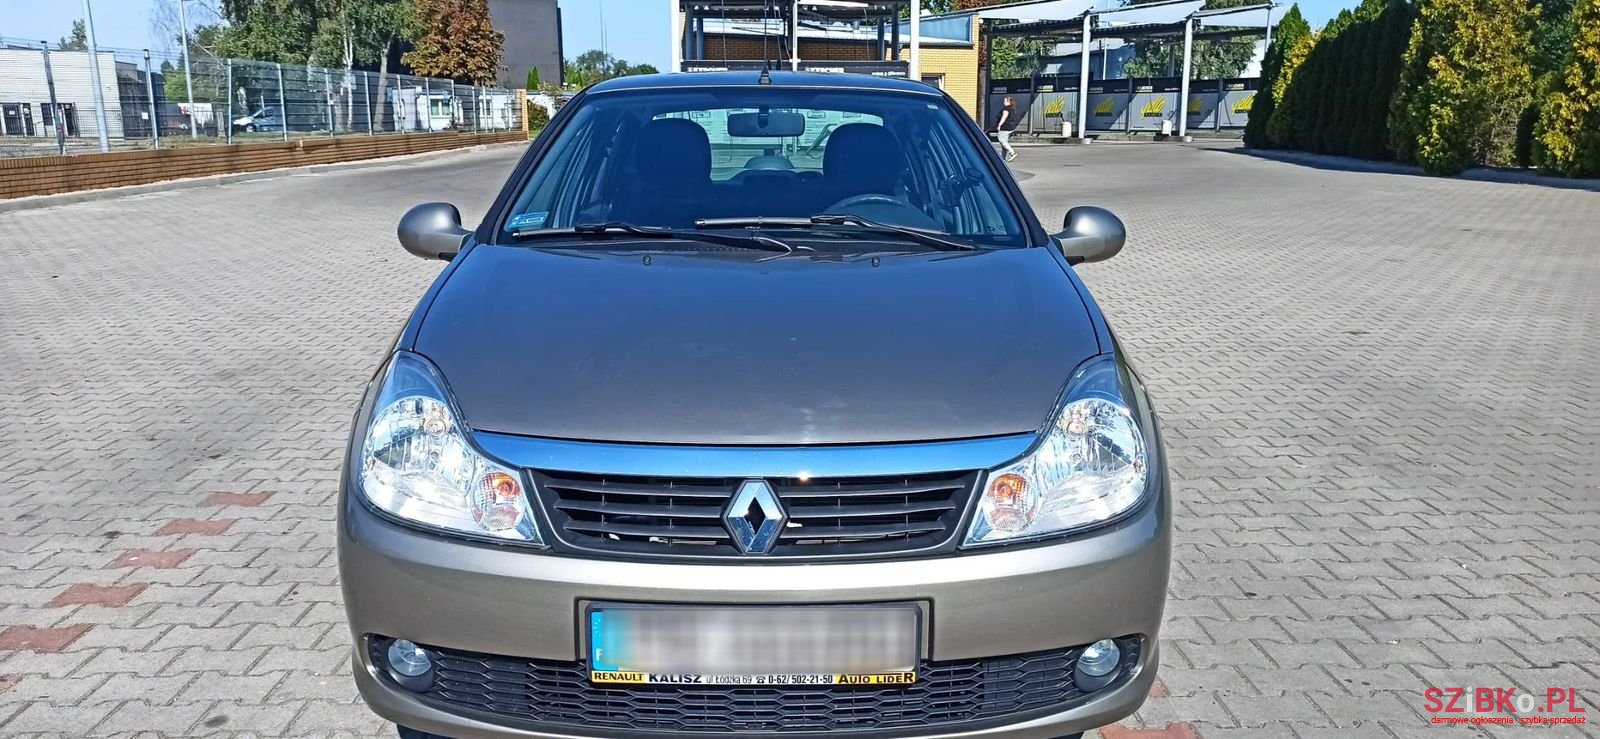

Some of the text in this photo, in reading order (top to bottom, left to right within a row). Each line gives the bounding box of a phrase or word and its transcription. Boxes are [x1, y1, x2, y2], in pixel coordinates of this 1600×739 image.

[594, 672, 644, 682] RENAULT
[648, 673, 702, 684] KALISZ
[792, 674, 833, 684] 502-21-50
[876, 672, 914, 684] LIDER
